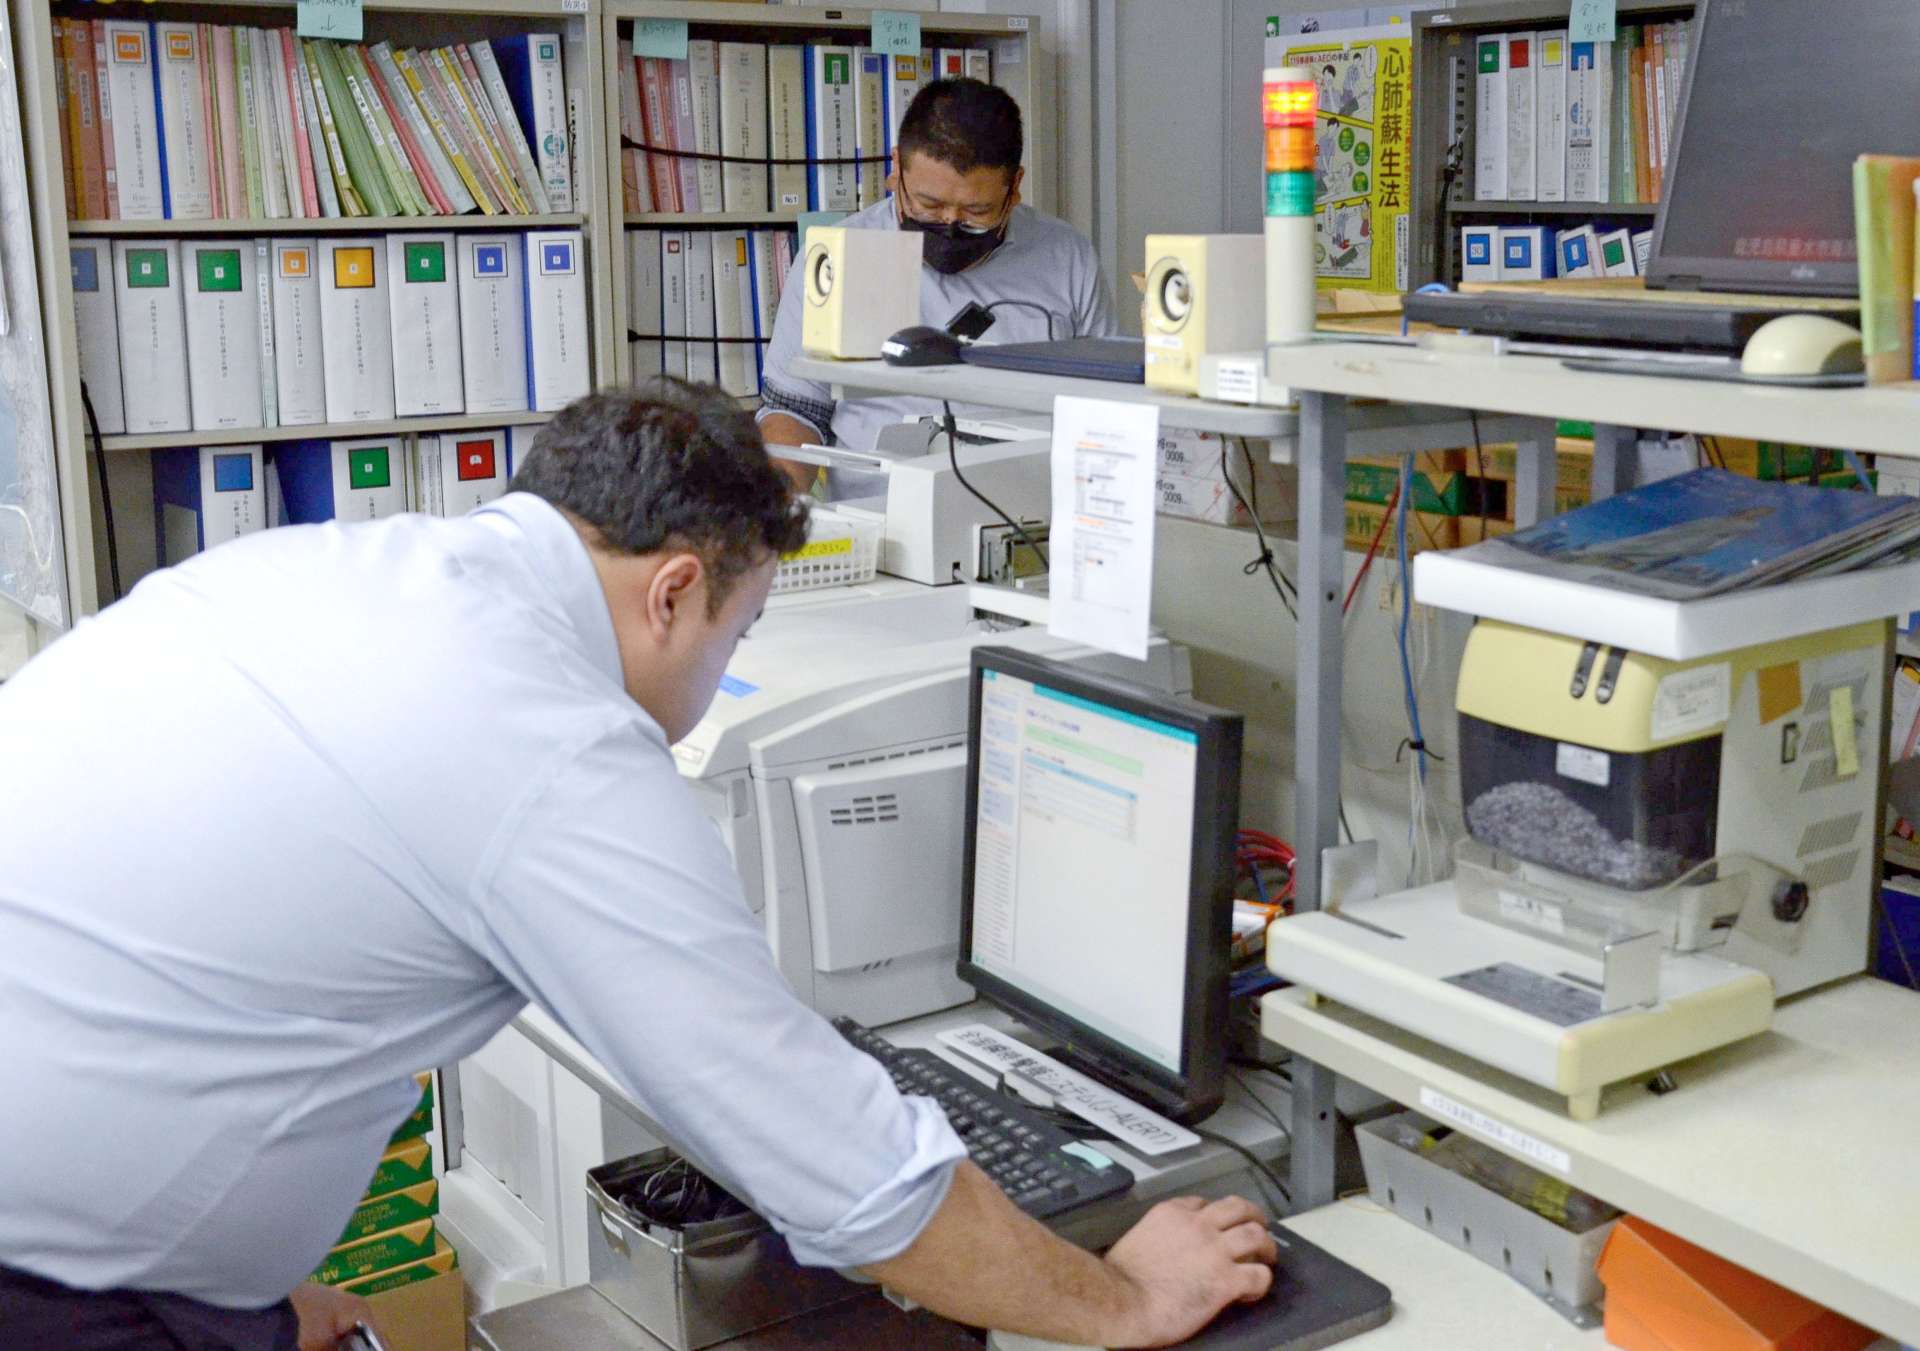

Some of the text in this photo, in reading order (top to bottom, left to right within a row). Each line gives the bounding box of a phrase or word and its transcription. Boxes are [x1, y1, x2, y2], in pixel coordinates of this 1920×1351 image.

[1378, 46, 1405, 208] 心肺蘇生法
